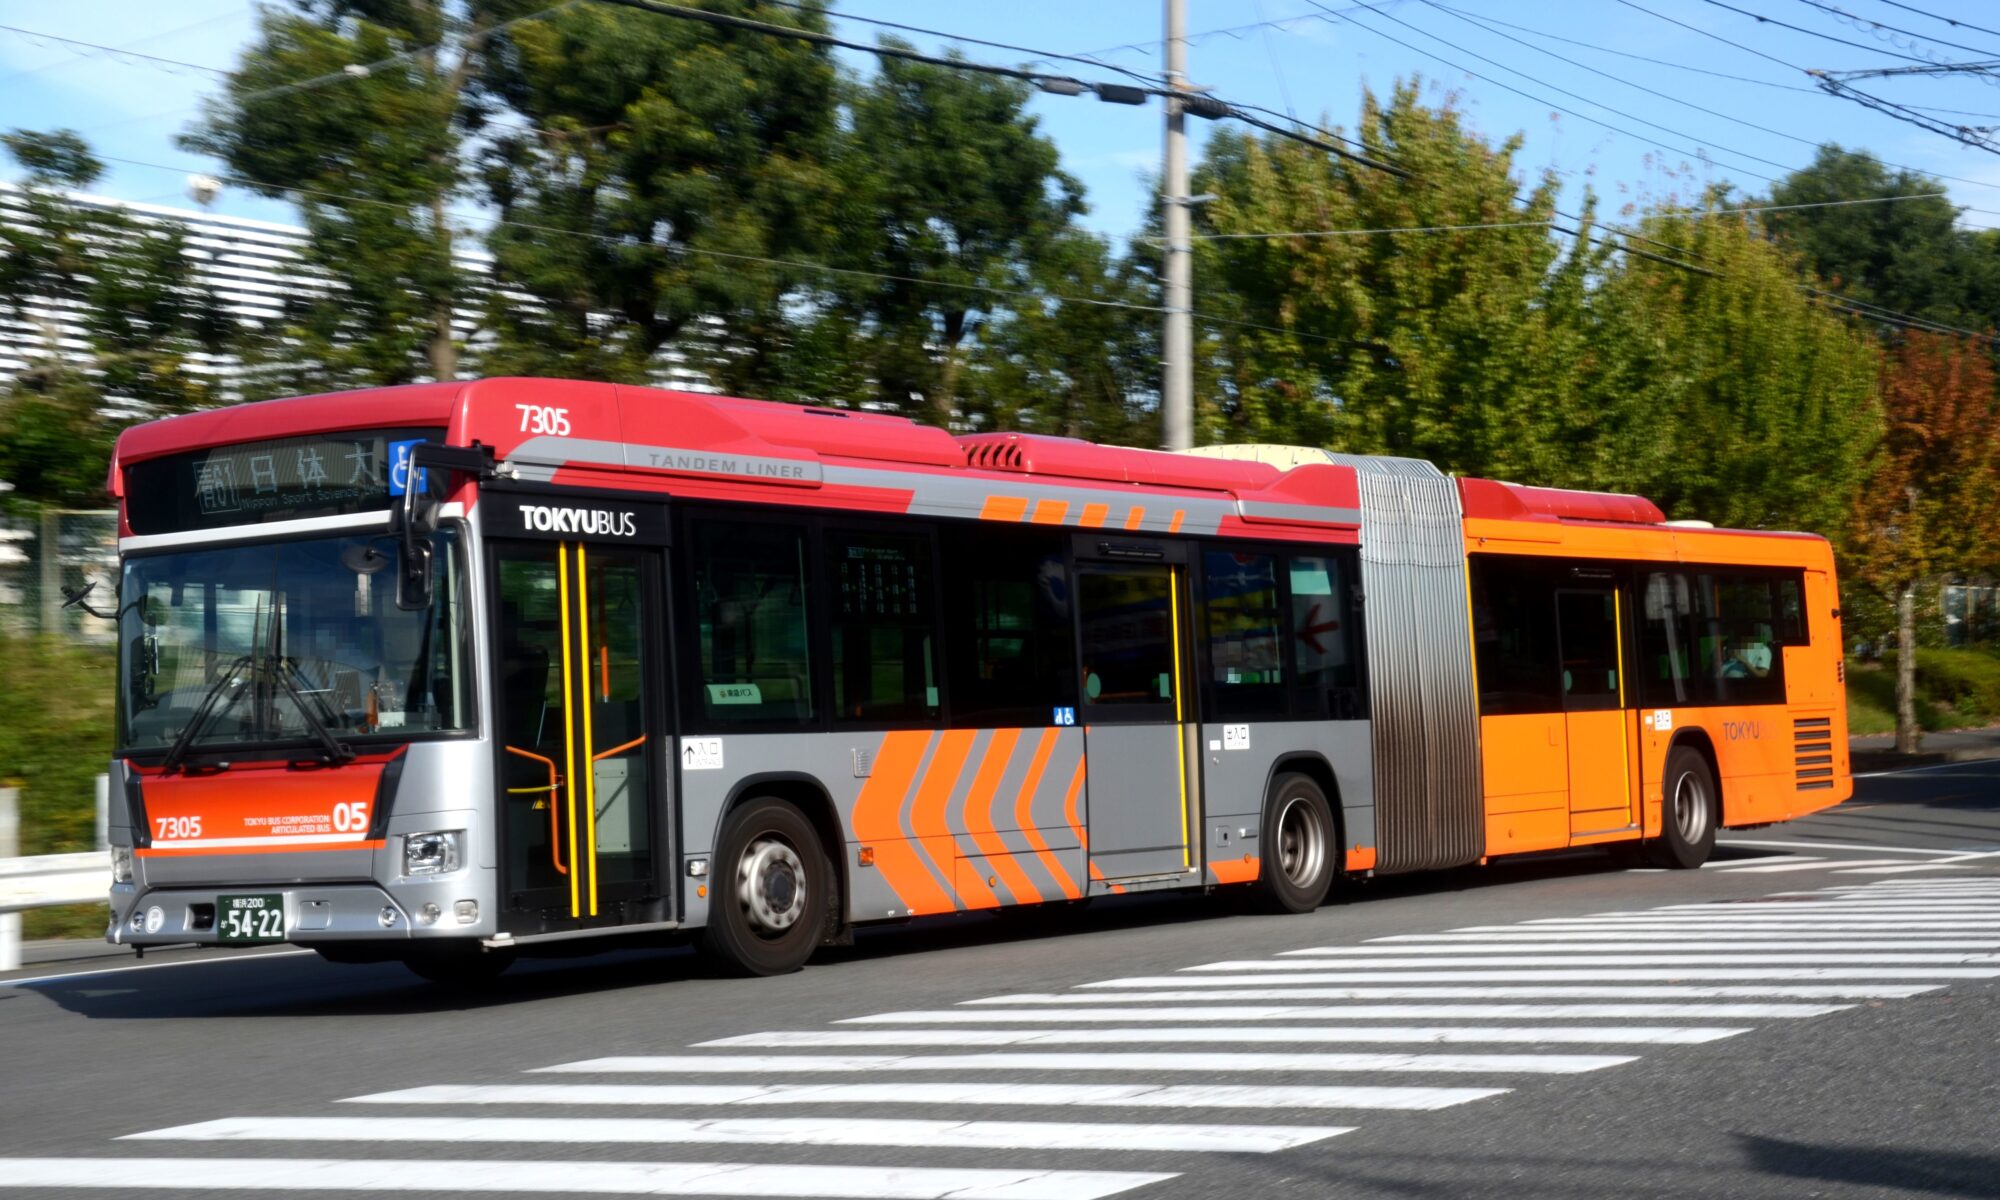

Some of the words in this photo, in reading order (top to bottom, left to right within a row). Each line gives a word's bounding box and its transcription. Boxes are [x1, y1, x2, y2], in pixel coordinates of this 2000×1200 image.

[515, 403, 571, 436] 7305
[649, 453, 736, 473] TANDEM
[746, 463, 804, 478] LINER
[519, 505, 636, 536] TOKYUBUS
[156, 816, 202, 838] 7305
[244, 817, 267, 826] TOKYU
[268, 816, 281, 825] BUS
[282, 814, 329, 825] CORPORATION
[271, 825, 316, 835] ARTICULATED
[333, 802, 368, 832] 05
[228, 909, 283, 938] 54-22
